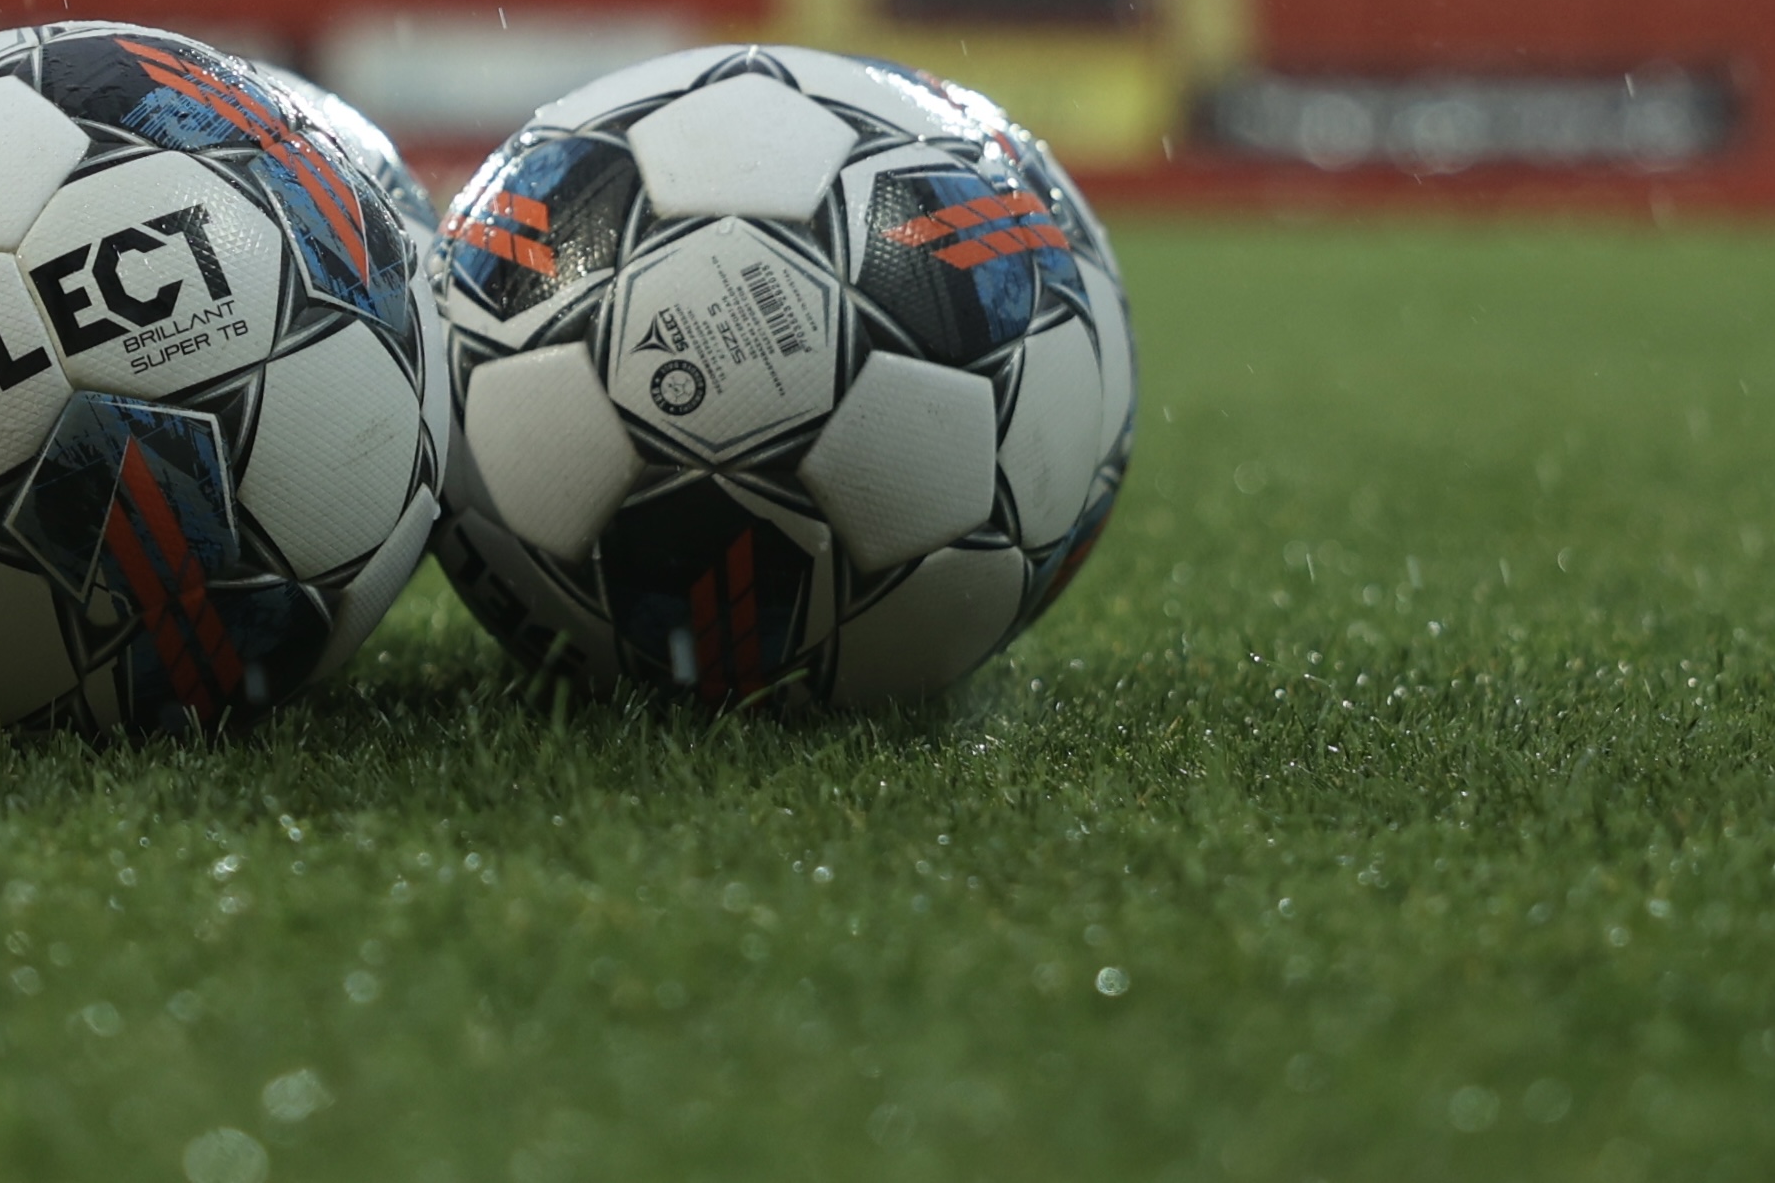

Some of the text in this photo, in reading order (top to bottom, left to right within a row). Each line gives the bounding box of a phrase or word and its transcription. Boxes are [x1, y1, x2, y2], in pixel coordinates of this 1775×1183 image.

[123, 299, 235, 354] BRILLANT
[130, 319, 249, 375] SUPER TB
[657, 306, 689, 353] SELECT
[706, 301, 746, 365] SIZE 5
